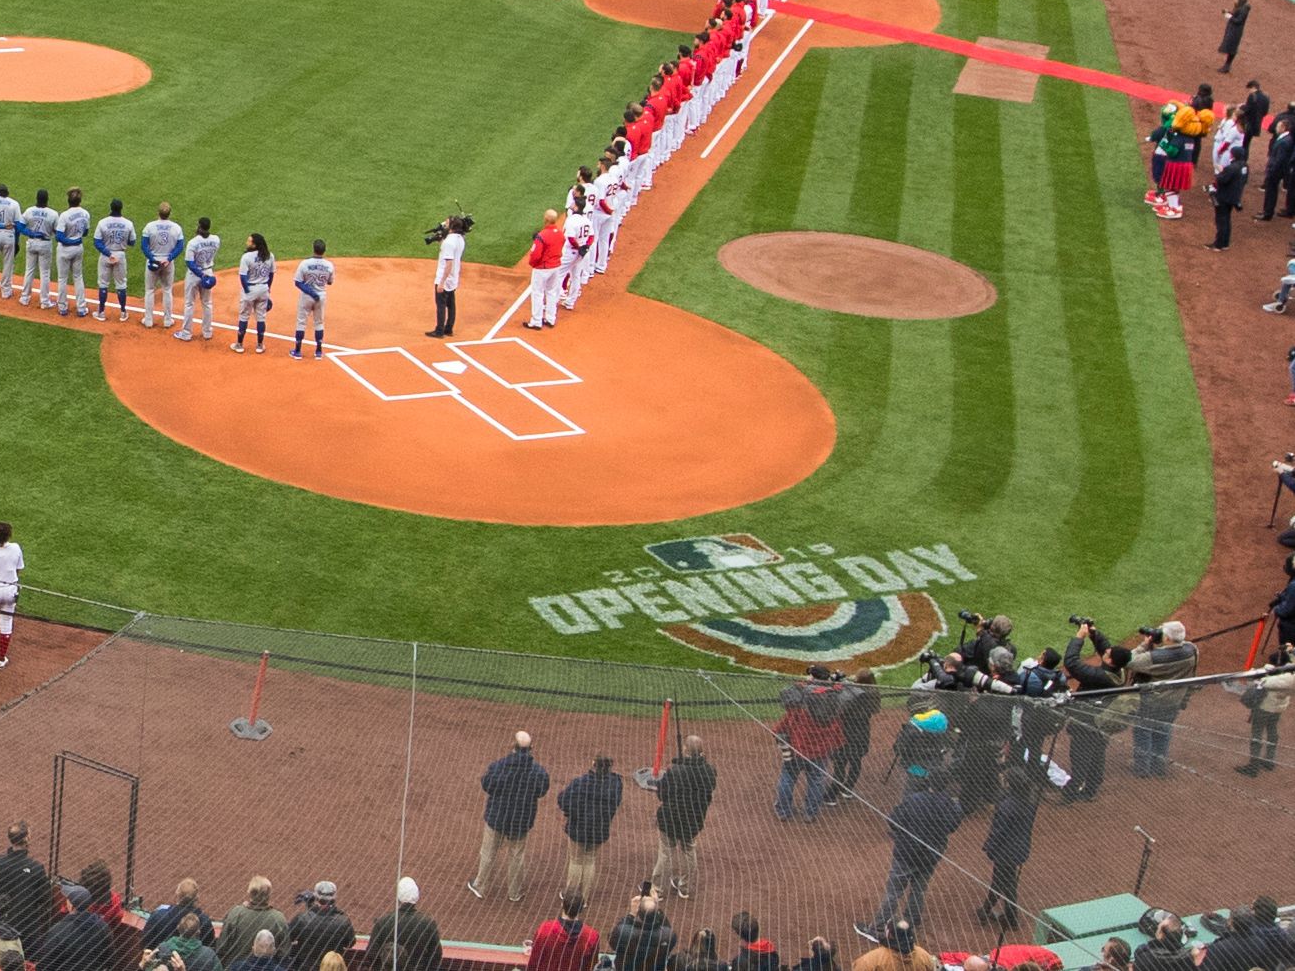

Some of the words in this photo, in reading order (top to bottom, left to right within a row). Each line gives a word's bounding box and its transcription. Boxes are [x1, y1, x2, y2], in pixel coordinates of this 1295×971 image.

[157, 231, 169, 247] 3
[528, 562, 848, 635] OPENING
[835, 542, 978, 594] DAY
